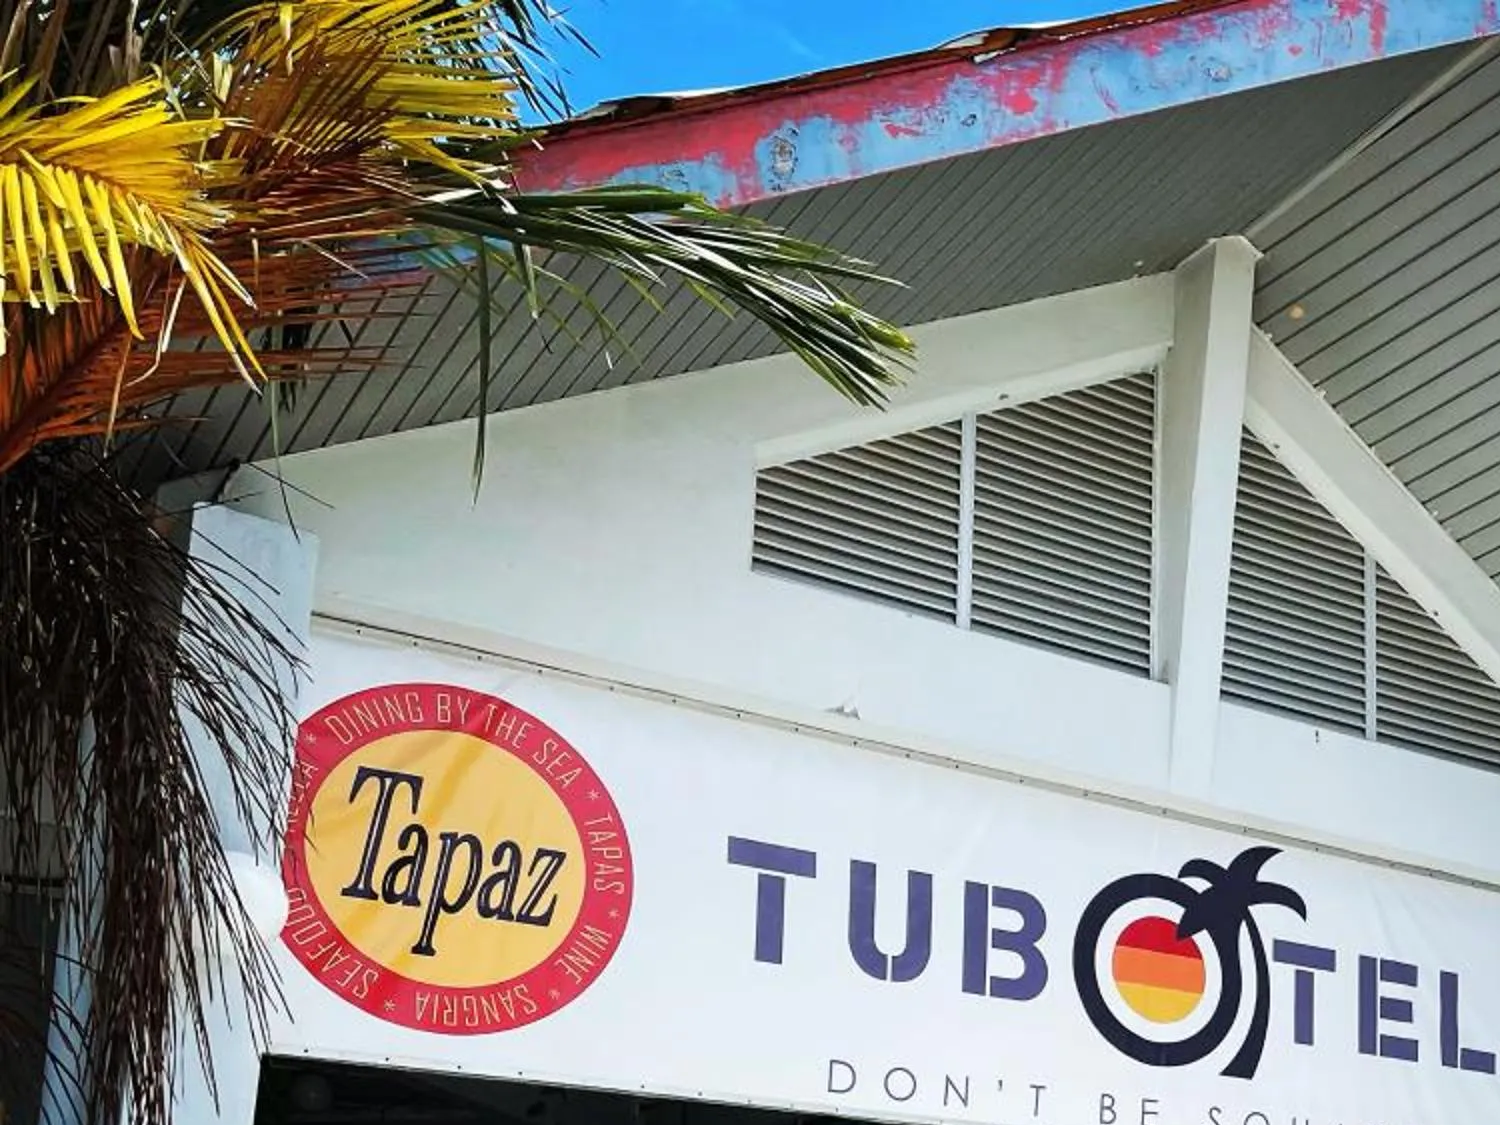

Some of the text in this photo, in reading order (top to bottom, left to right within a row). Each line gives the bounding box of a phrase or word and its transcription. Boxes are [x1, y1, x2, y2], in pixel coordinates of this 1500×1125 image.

[324, 692, 584, 790] DINING BY THE SEA
[340, 765, 567, 957] Tapaz
[584, 811, 626, 896] TAPAS
[554, 925, 613, 985] WINE
[414, 984, 538, 1027] SANGRIA
[827, 1058, 1047, 1118] DON'T
